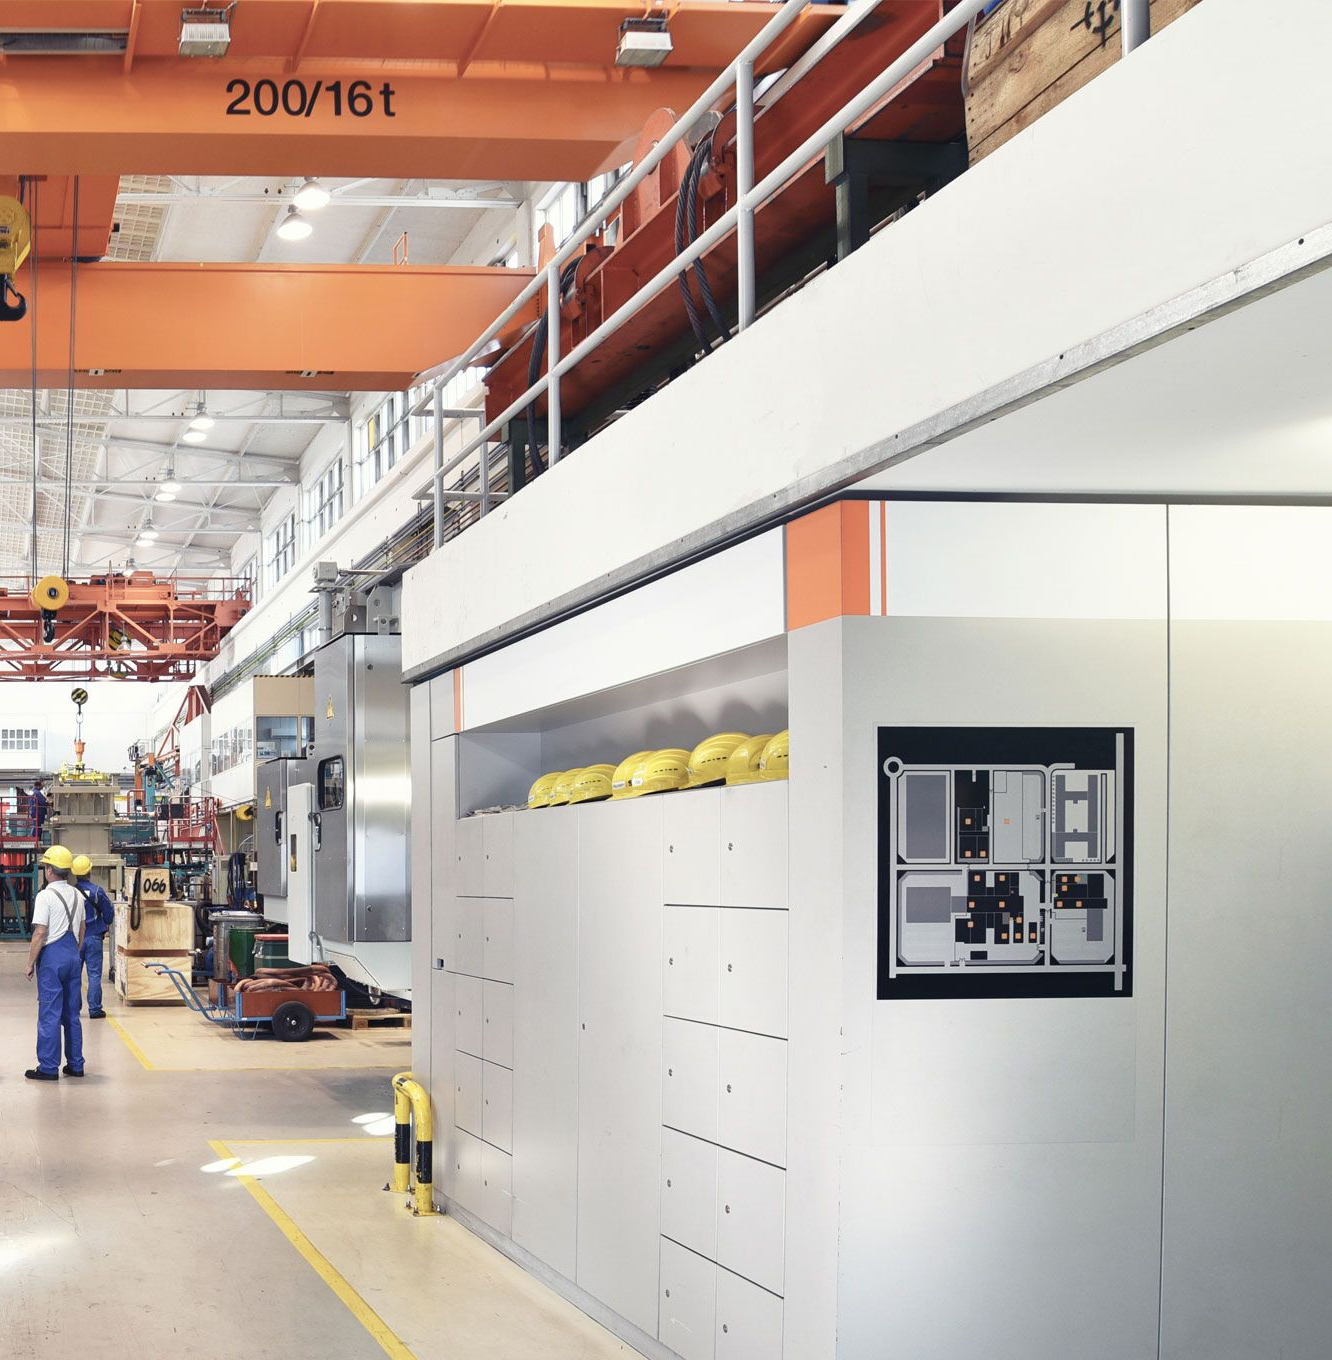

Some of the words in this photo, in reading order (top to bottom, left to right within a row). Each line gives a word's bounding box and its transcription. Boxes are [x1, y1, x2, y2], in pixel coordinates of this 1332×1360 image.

[226, 78, 373, 117] 200/16
[379, 82, 396, 117] t
[143, 877, 166, 894] 066
